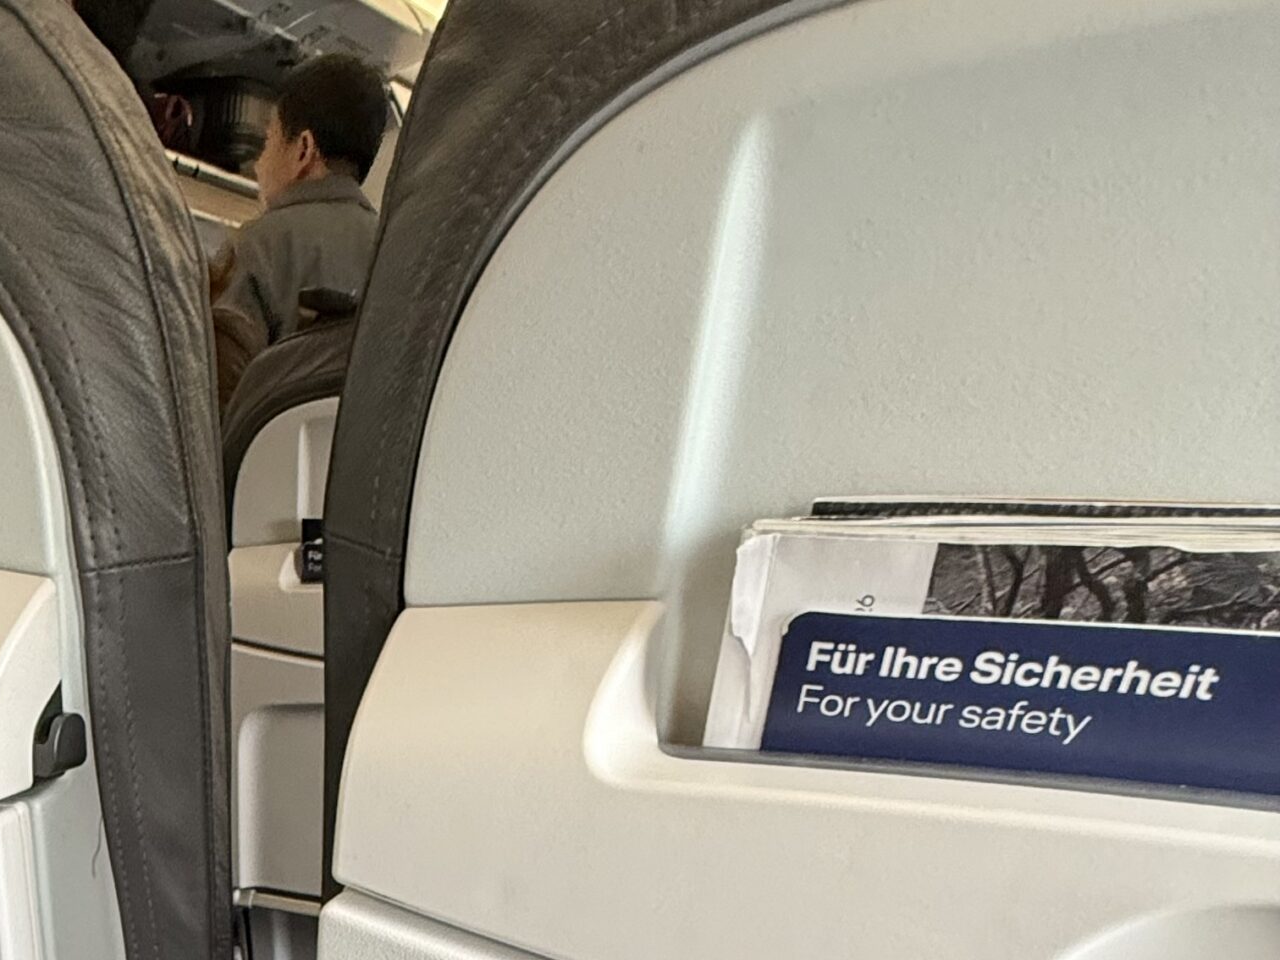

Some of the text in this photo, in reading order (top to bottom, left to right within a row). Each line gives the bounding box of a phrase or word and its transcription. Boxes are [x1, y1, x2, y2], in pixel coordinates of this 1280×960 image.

[806, 640, 1220, 701] Für Ihre Sicherheit
[796, 684, 1093, 746] For your safety
